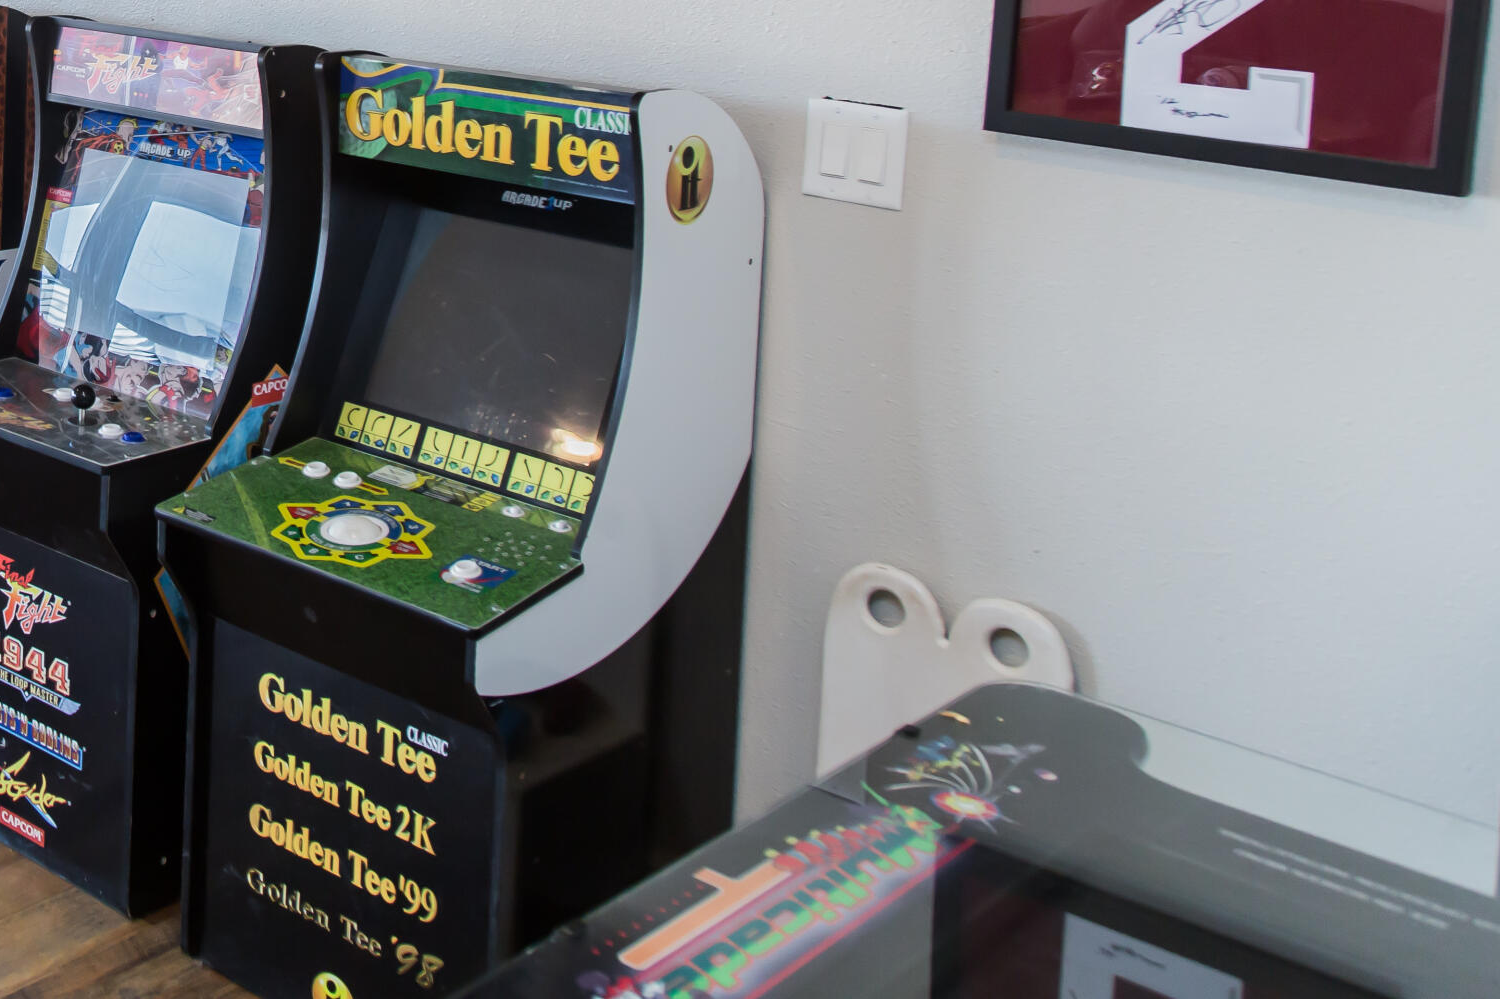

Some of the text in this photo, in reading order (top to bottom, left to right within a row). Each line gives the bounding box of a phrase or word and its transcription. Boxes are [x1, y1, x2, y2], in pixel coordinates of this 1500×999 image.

[84, 53, 159, 95] Fight
[345, 86, 621, 182] Golden Tee
[574, 106, 632, 136] CLASSI
[10, 674, 29, 692] LOOP
[30, 683, 60, 707] MASTER
[258, 672, 437, 783] Golden Tee
[406, 725, 449, 758] CLASSIC
[1, 810, 43, 843] CAPCOM
[253, 741, 437, 856] Golden Tee 2K
[248, 803, 438, 924] Golden Tee '99
[246, 868, 445, 988] Golden Tee '98
